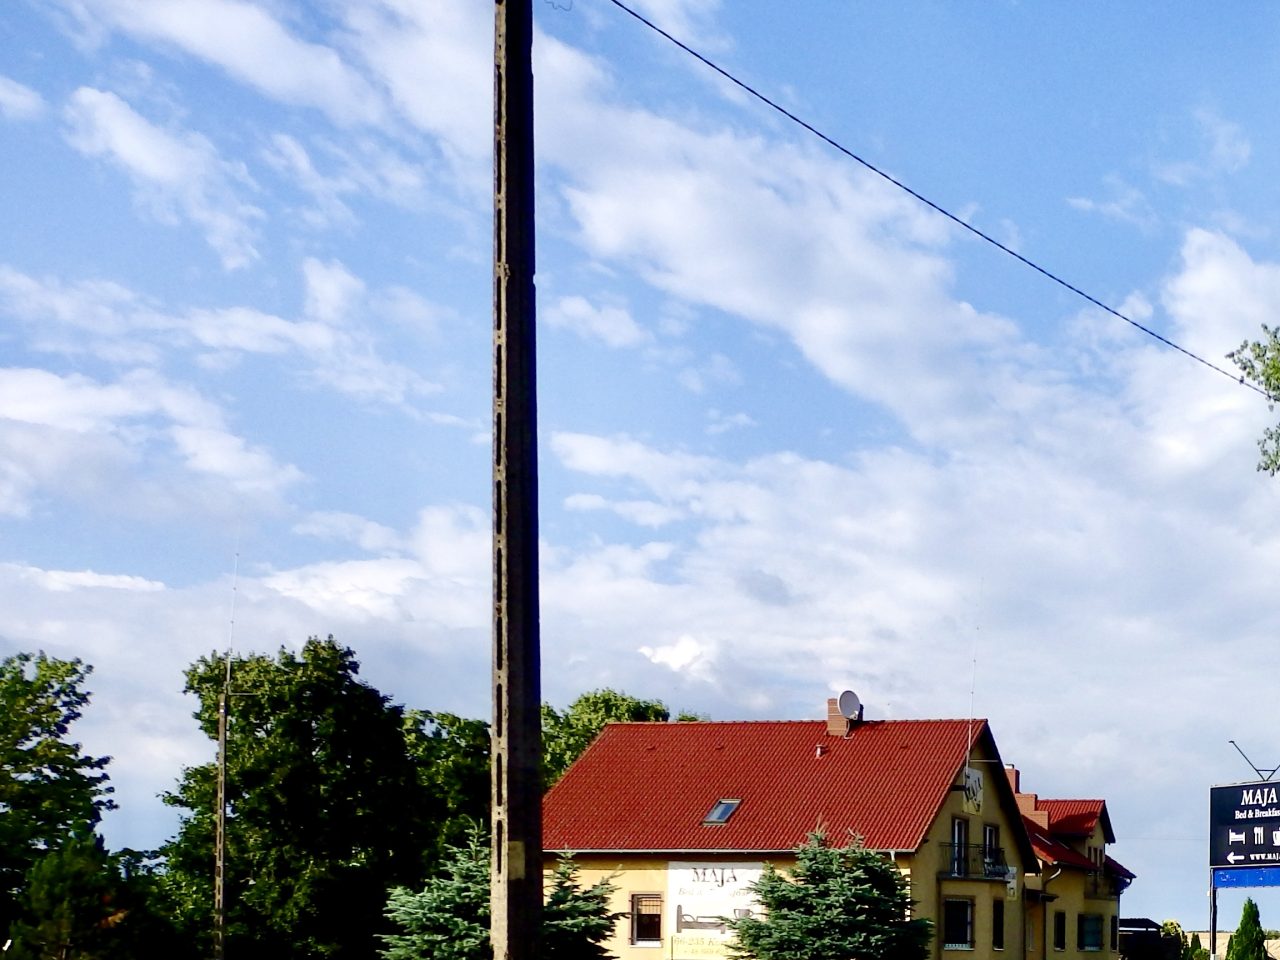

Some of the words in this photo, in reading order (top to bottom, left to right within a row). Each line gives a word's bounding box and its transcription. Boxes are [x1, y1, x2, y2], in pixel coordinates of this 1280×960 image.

[1240, 787, 1278, 807] MAJA
[1234, 809, 1247, 820] Bed
[1247, 809, 1254, 819] &
[692, 867, 738, 887] MAJA
